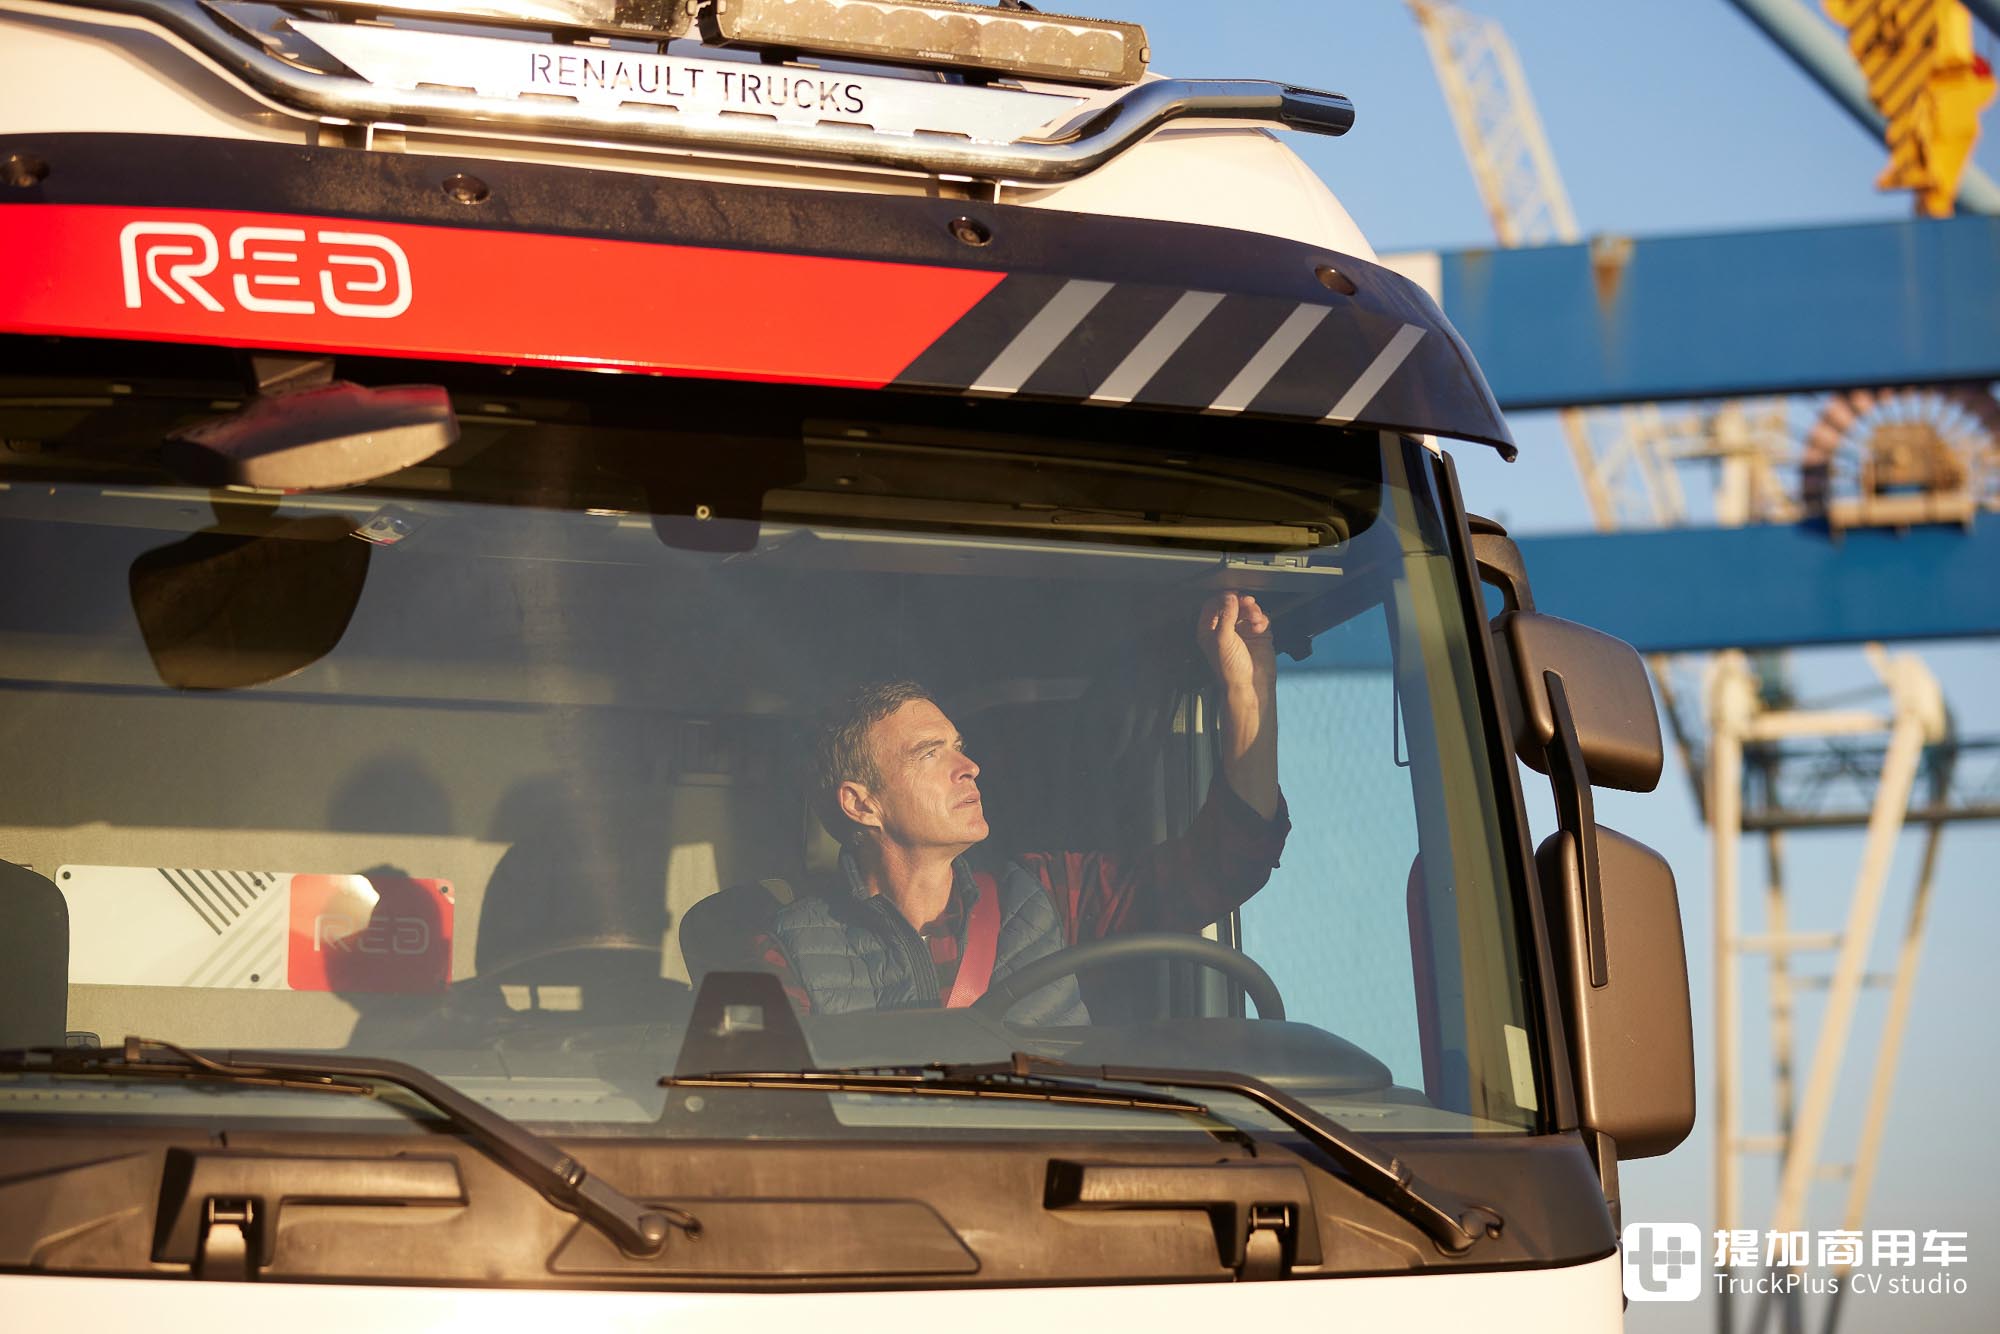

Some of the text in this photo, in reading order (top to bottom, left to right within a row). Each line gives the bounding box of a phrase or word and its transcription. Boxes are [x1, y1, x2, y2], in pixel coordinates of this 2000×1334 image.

[531, 53, 865, 114] RENAULT TRUCKS
[120, 221, 413, 318] RED
[314, 914, 430, 954] RED
